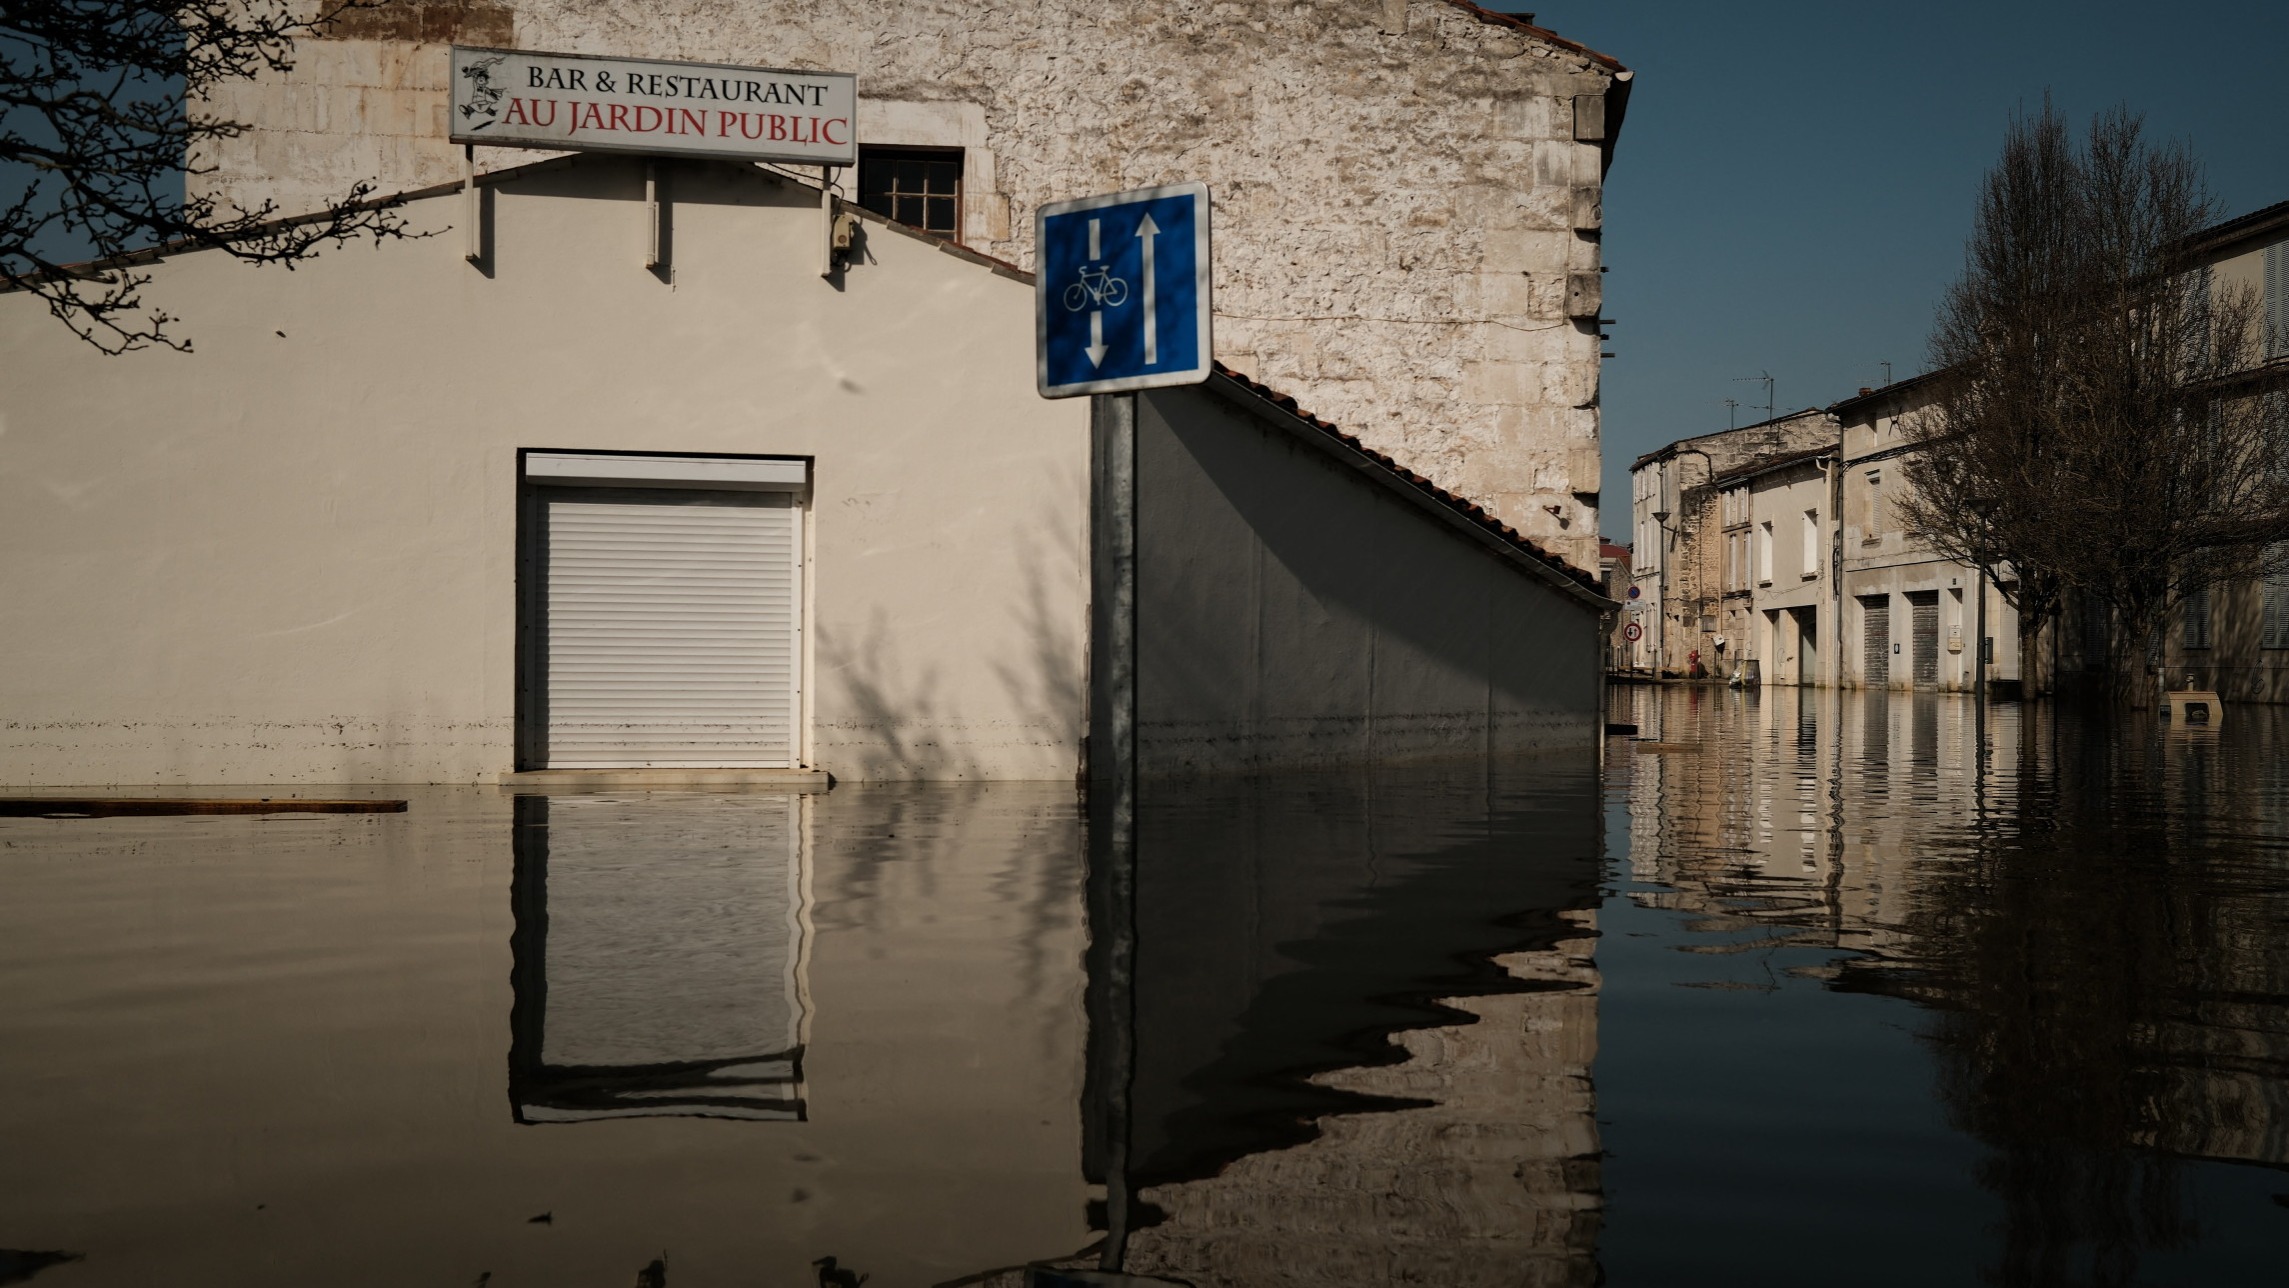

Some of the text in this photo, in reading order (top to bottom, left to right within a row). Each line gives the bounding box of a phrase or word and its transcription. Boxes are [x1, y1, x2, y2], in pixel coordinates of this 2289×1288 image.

[527, 66, 828, 106] BAR & RESTAURANT
[501, 97, 849, 146] AU JARDIN PUBLIC
